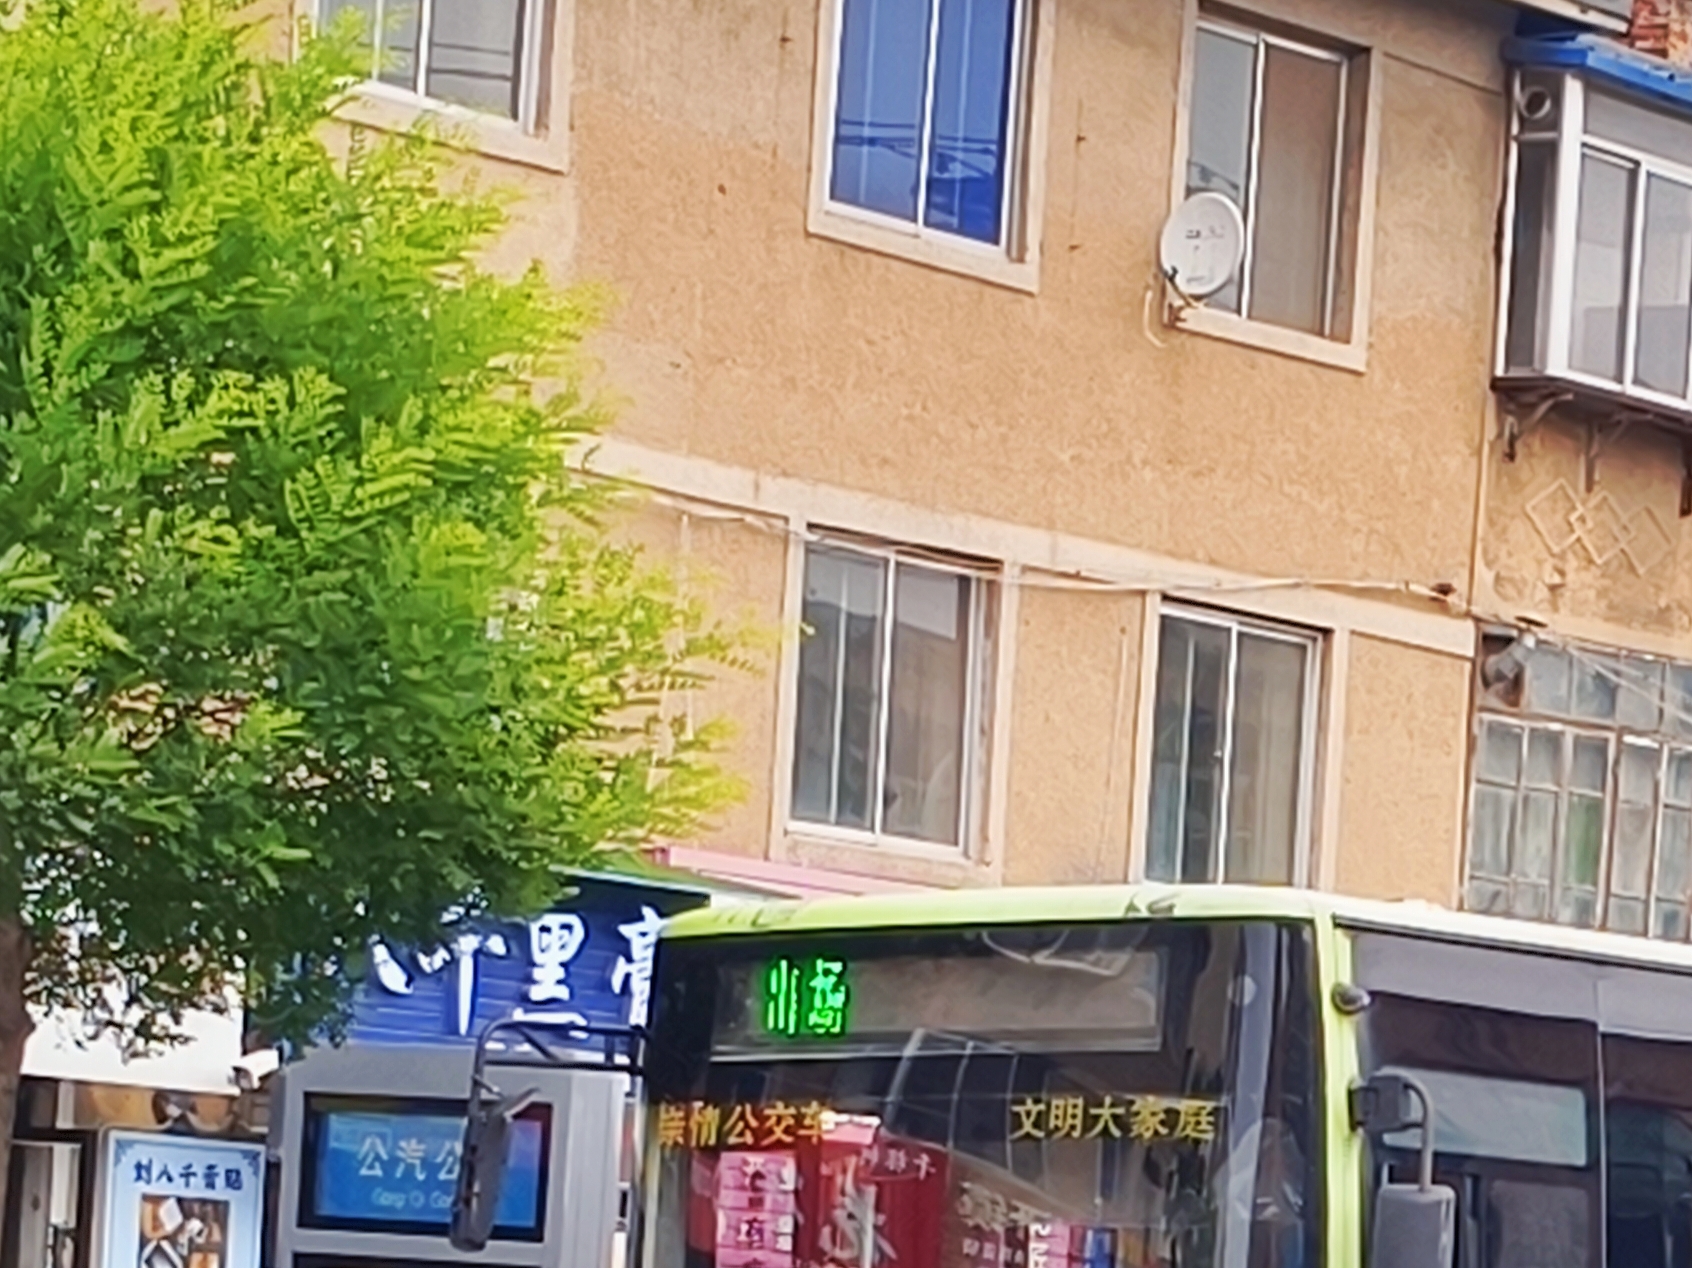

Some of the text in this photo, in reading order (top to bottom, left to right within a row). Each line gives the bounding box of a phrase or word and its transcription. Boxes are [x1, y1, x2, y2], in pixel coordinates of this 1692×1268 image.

[1010, 1095, 1216, 1140] 文明大家庭
